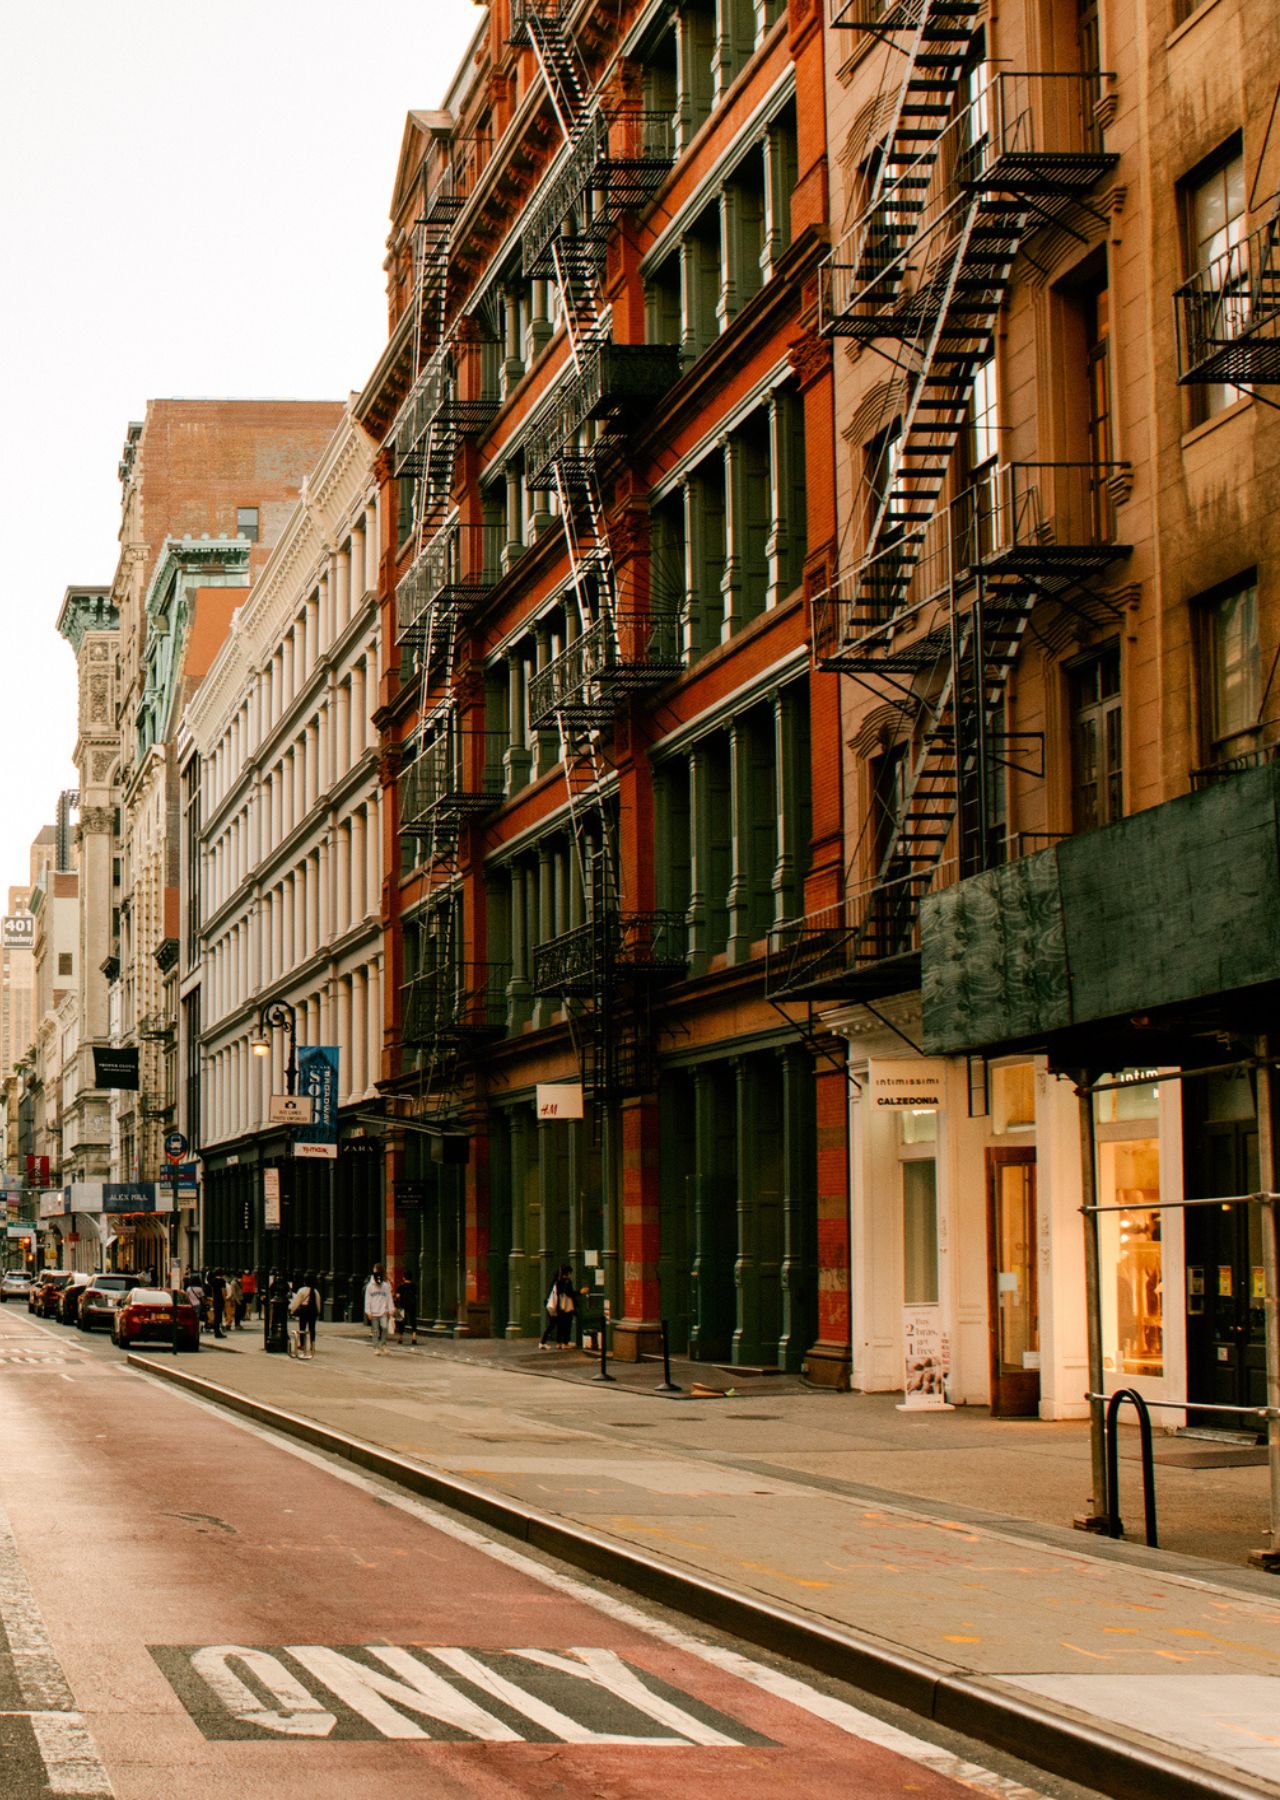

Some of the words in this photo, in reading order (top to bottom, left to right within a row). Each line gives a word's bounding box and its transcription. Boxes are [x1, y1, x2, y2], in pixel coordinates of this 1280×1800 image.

[4, 919, 32, 931] 401
[876, 1078, 939, 1086] intimissimi
[876, 1097, 939, 1106] CALZEDONIA
[109, 1193, 129, 1201] ALEX
[189, 1644, 747, 1747] ONLY
